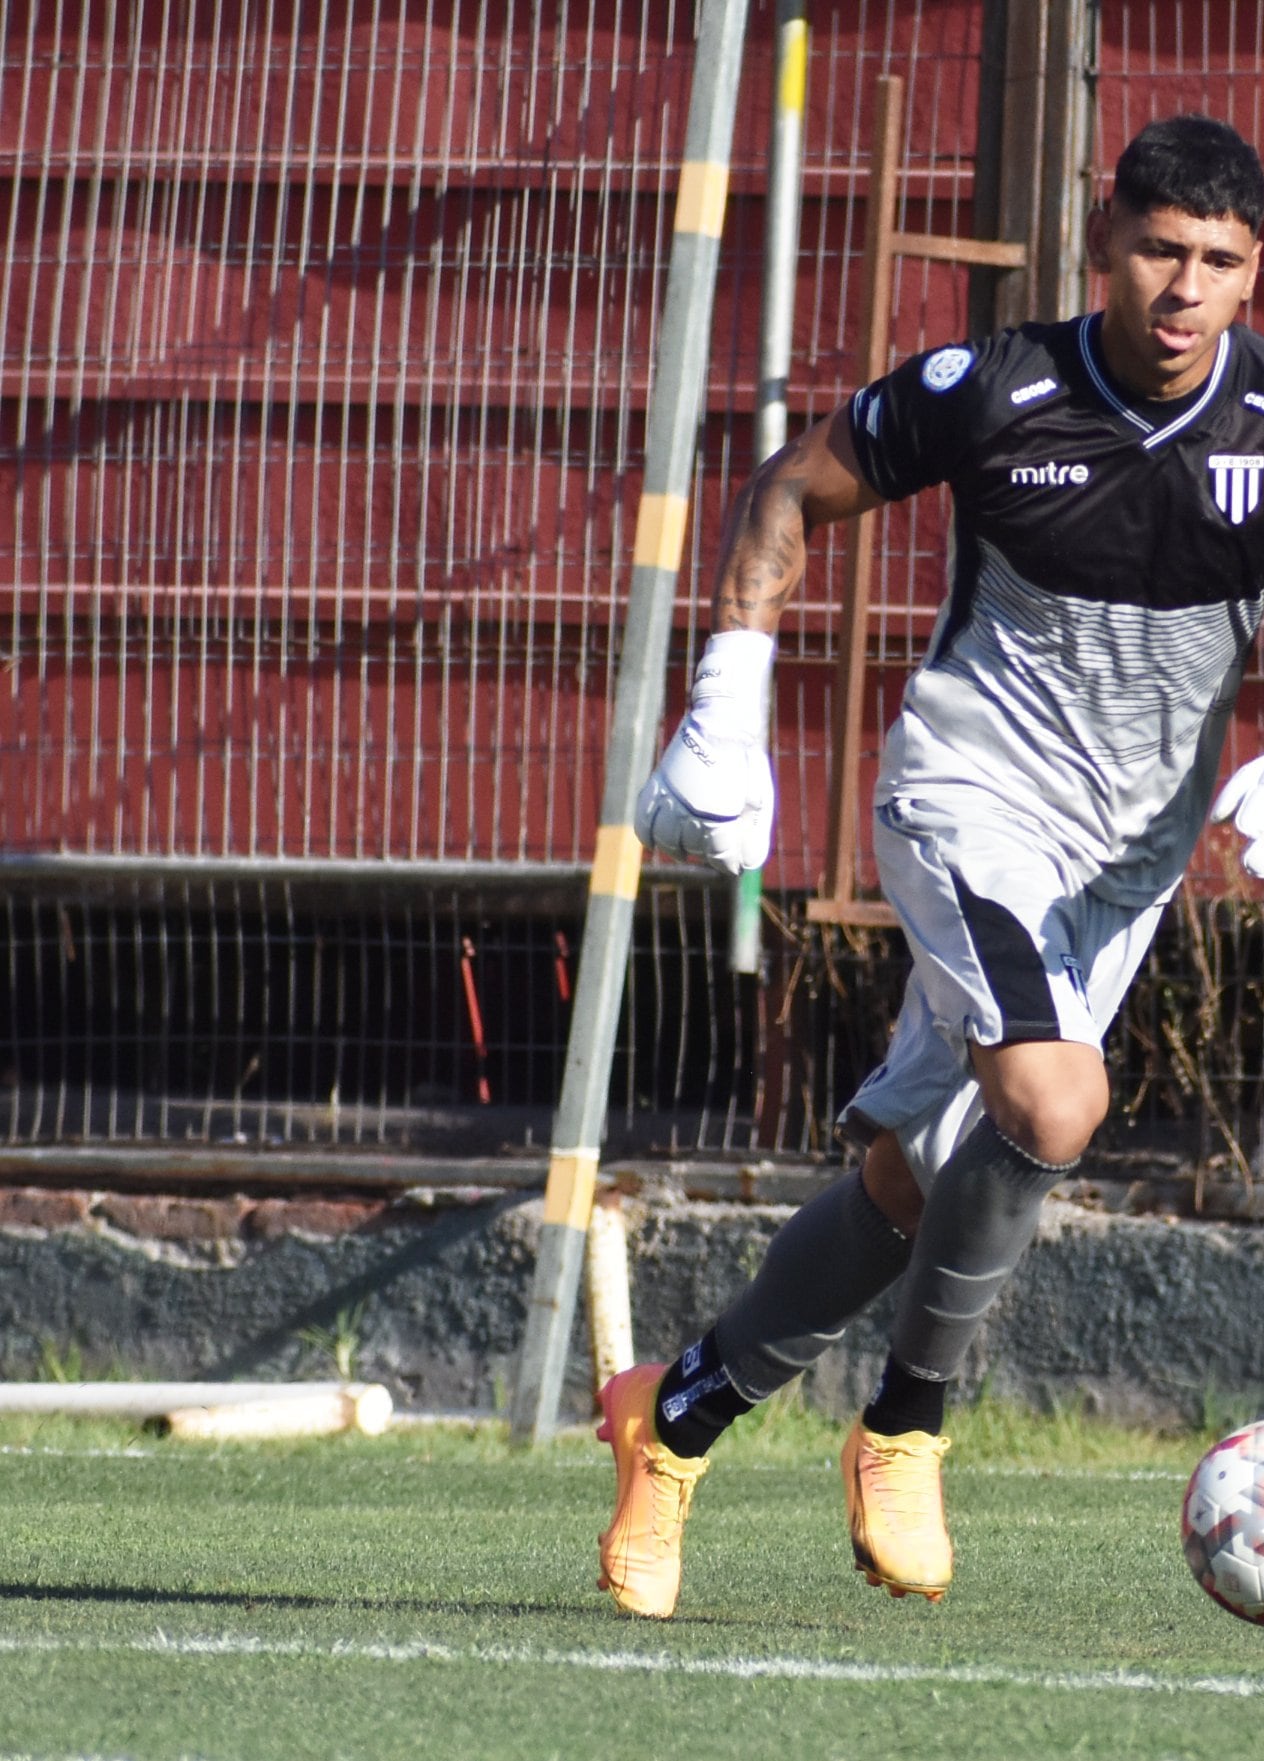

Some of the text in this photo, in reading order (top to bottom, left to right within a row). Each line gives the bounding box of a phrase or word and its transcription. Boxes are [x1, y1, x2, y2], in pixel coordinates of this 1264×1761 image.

[1011, 378, 1057, 404] CEOSA
[1011, 461, 1090, 485] mitre
[1239, 457, 1261, 466] 1908
